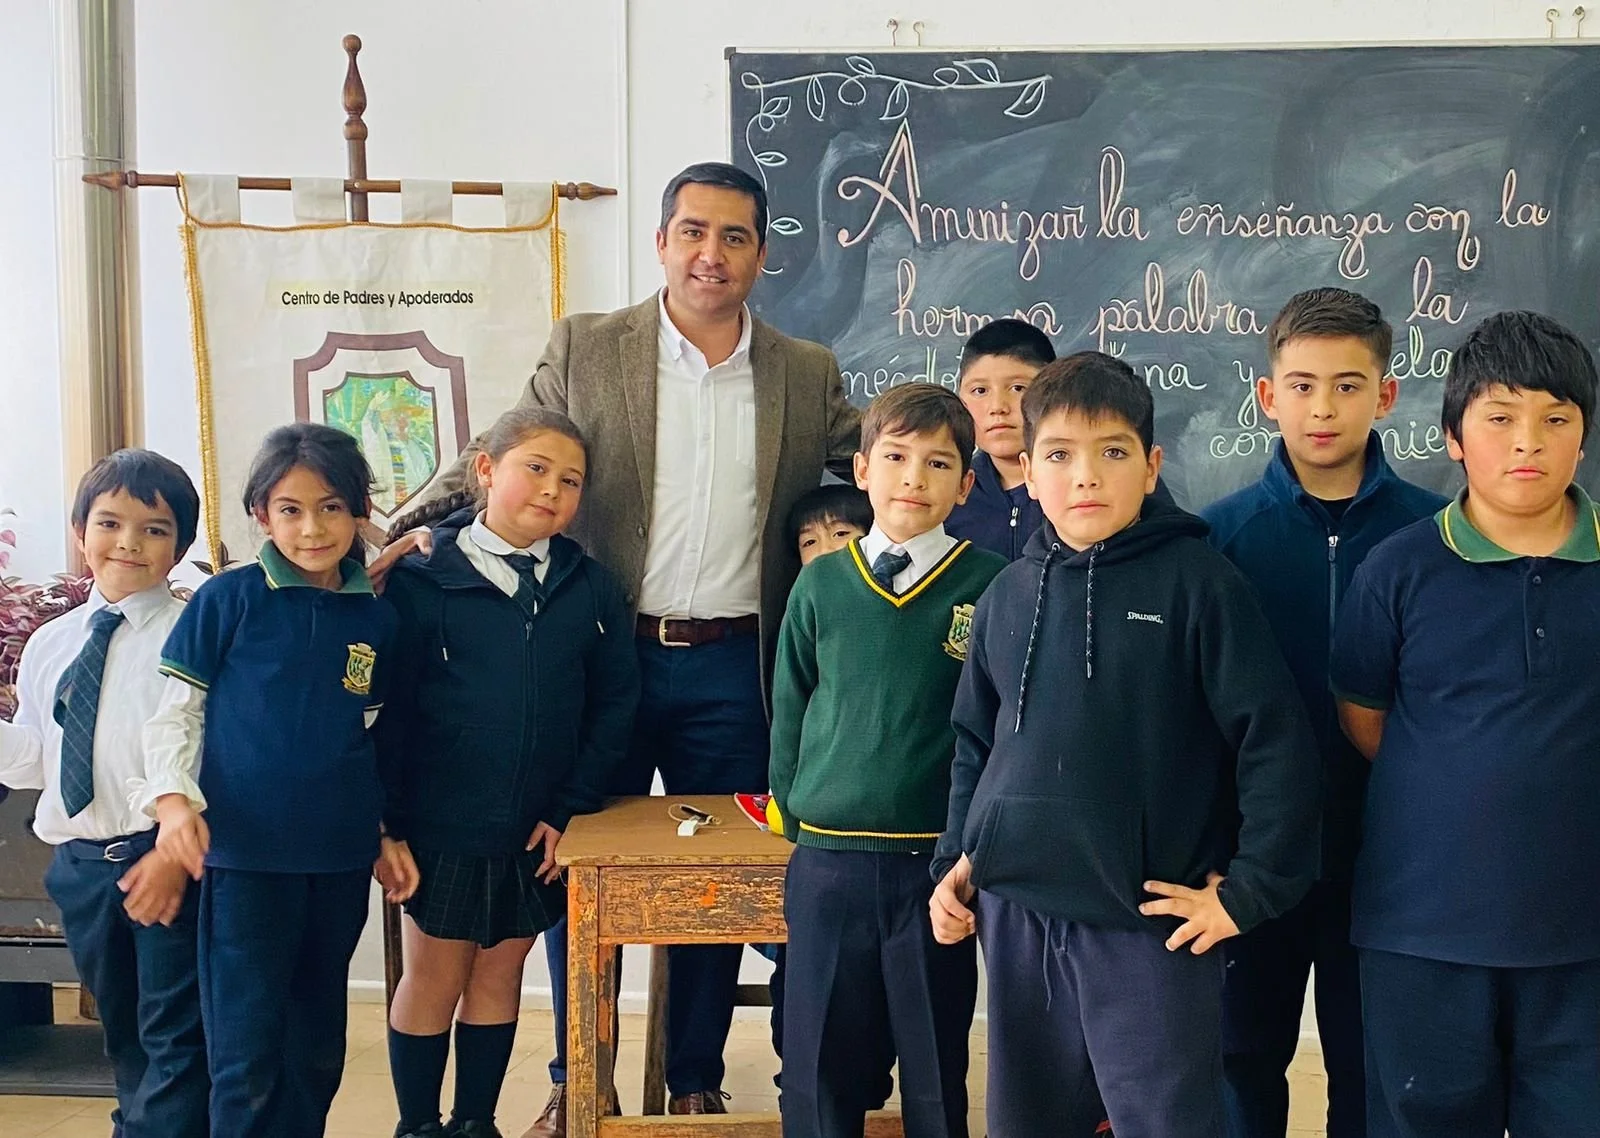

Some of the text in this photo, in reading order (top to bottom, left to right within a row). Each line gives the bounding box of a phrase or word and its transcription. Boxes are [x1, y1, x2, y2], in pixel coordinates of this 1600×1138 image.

[837, 118, 1089, 281] Amenizar
[1097, 146, 1150, 240] la
[1405, 202, 1480, 271] con
[1497, 168, 1551, 228] la
[281, 290, 474, 308] Centro de Padres y Apoderados
[891, 256, 1469, 354] herma palabra la
[1232, 360, 1258, 429] y
[1126, 611, 1164, 625] SPALDING
